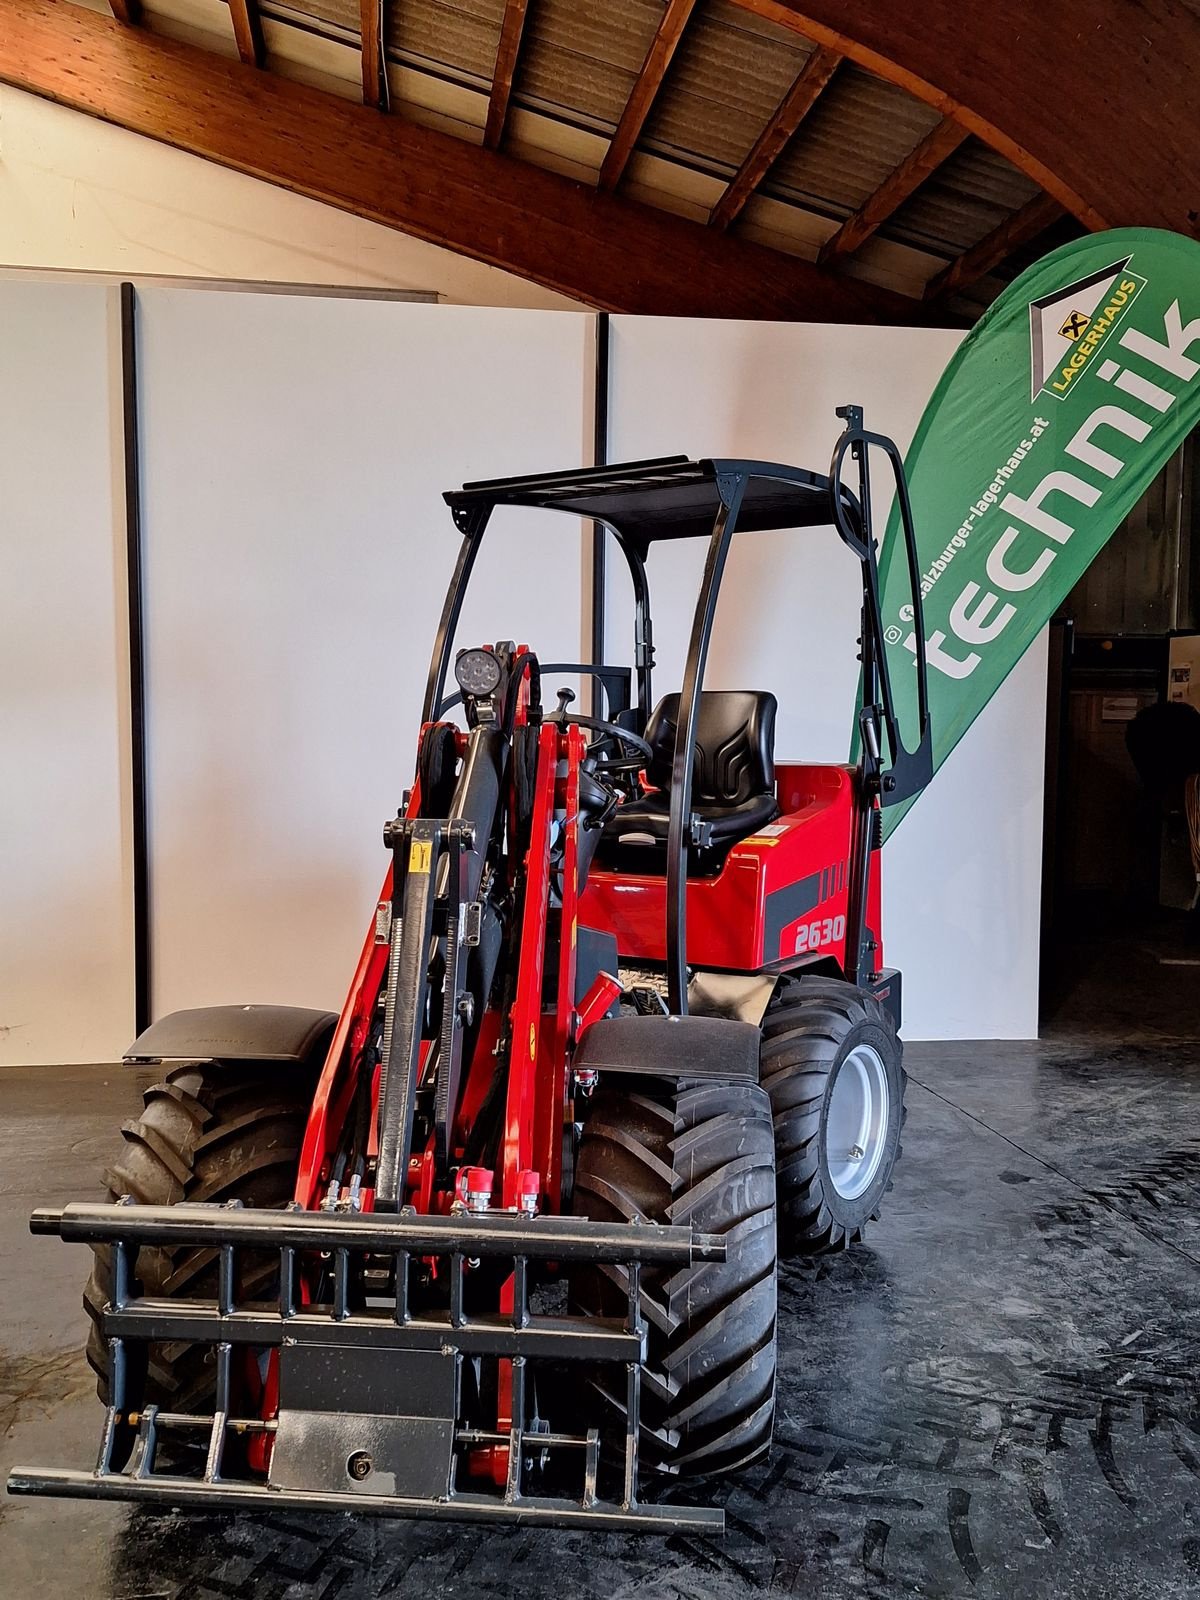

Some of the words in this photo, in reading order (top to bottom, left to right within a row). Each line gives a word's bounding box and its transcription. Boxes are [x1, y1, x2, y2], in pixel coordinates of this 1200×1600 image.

[1052, 279, 1136, 391] LAGERHAUS
[903, 297, 1200, 679] technik
[795, 914, 846, 953] 2630
